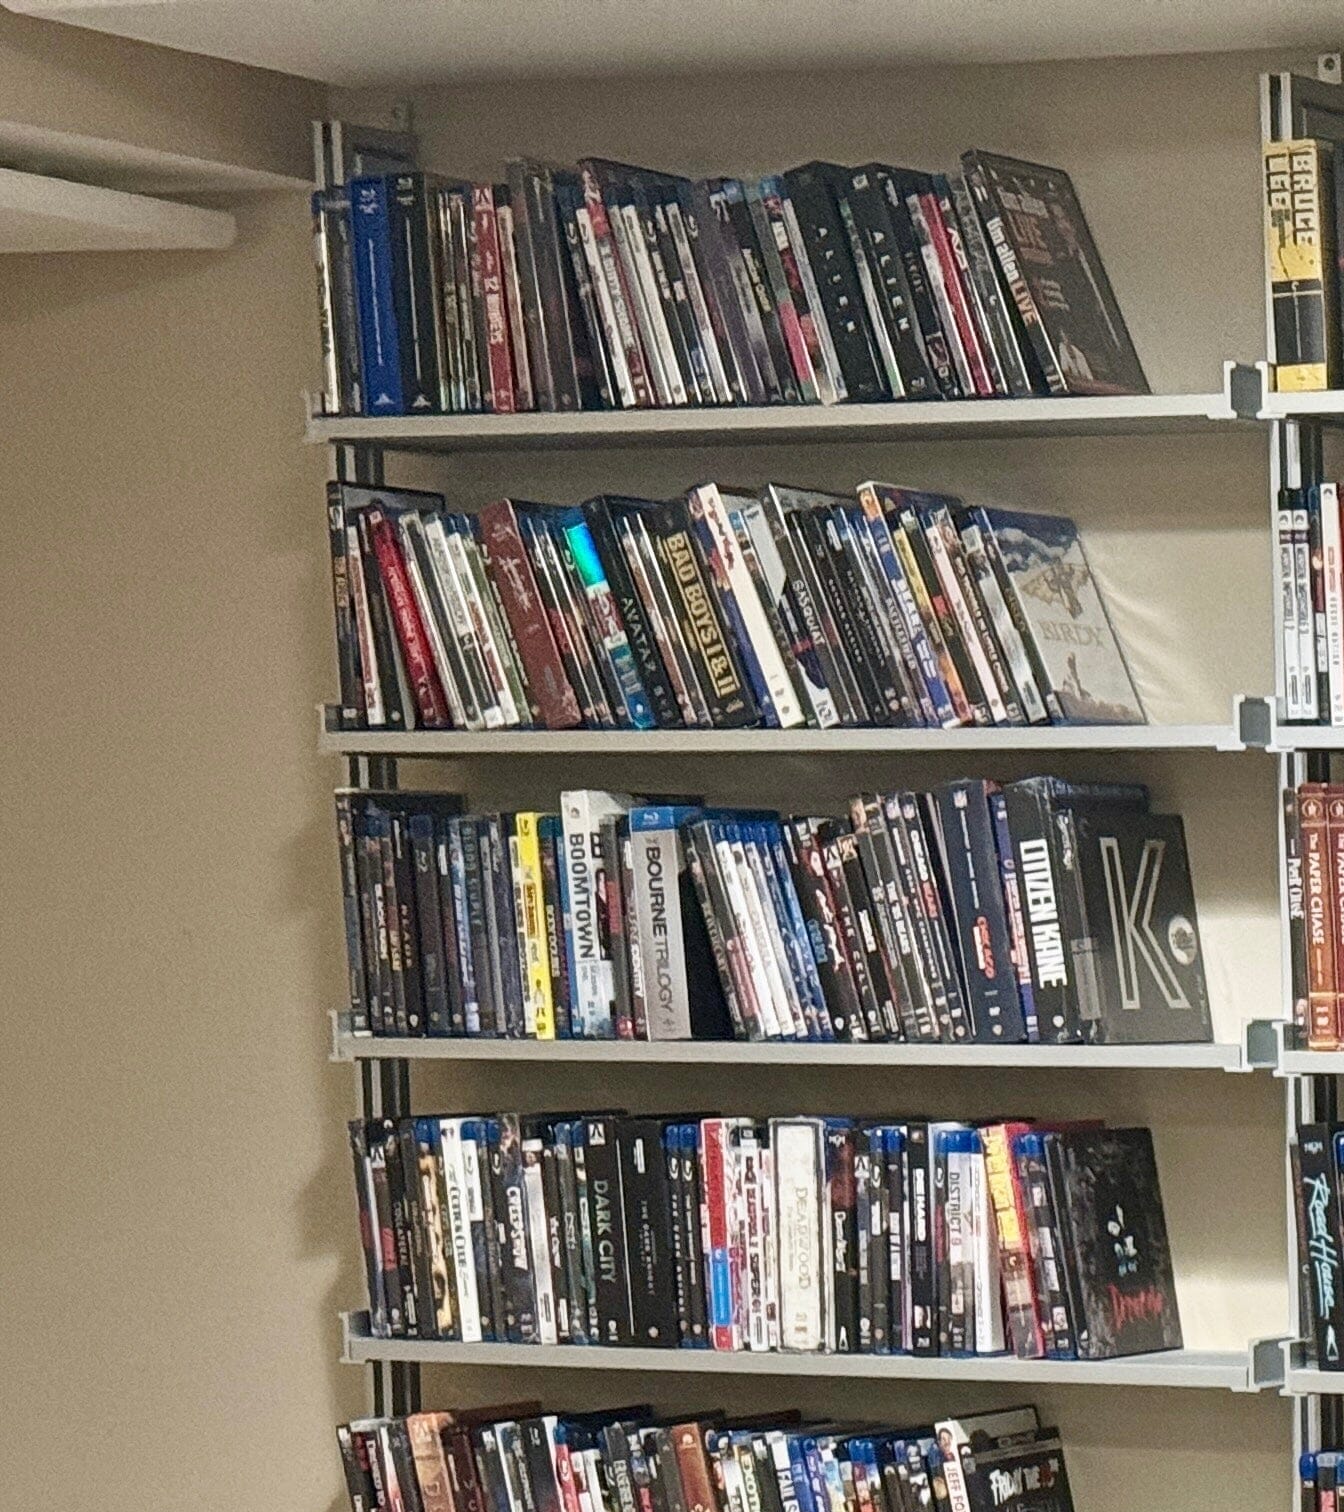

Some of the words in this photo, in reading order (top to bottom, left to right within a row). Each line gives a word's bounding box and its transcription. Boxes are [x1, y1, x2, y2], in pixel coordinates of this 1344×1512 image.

[1267, 155, 1290, 209] LEE
[1290, 152, 1315, 246] BRUCE
[873, 232, 911, 332] ALIEN
[1010, 281, 1038, 327] LIVE
[667, 534, 695, 581] BAD
[621, 597, 658, 672] AVATAR
[684, 585, 713, 634] BOYS
[1042, 620, 1105, 648] BIRDY
[711, 656, 730, 674] &
[718, 678, 736, 695] II
[569, 834, 595, 959] BOOMTOWN
[647, 848, 667, 937] BOURNE
[1019, 839, 1057, 922] CITIZEN
[655, 934, 674, 1012] TRILOGY
[1032, 923, 1067, 988] KANE
[507, 1187, 528, 1271] CREEPSHOW
[594, 1180, 613, 1235] DARK
[950, 1172, 961, 1233] DISTRICT
[599, 1240, 616, 1282] CITY
[952, 1237, 962, 1246] 9
[778, 1471, 794, 1497] FAIL
[946, 1469, 960, 1492] JEFF
